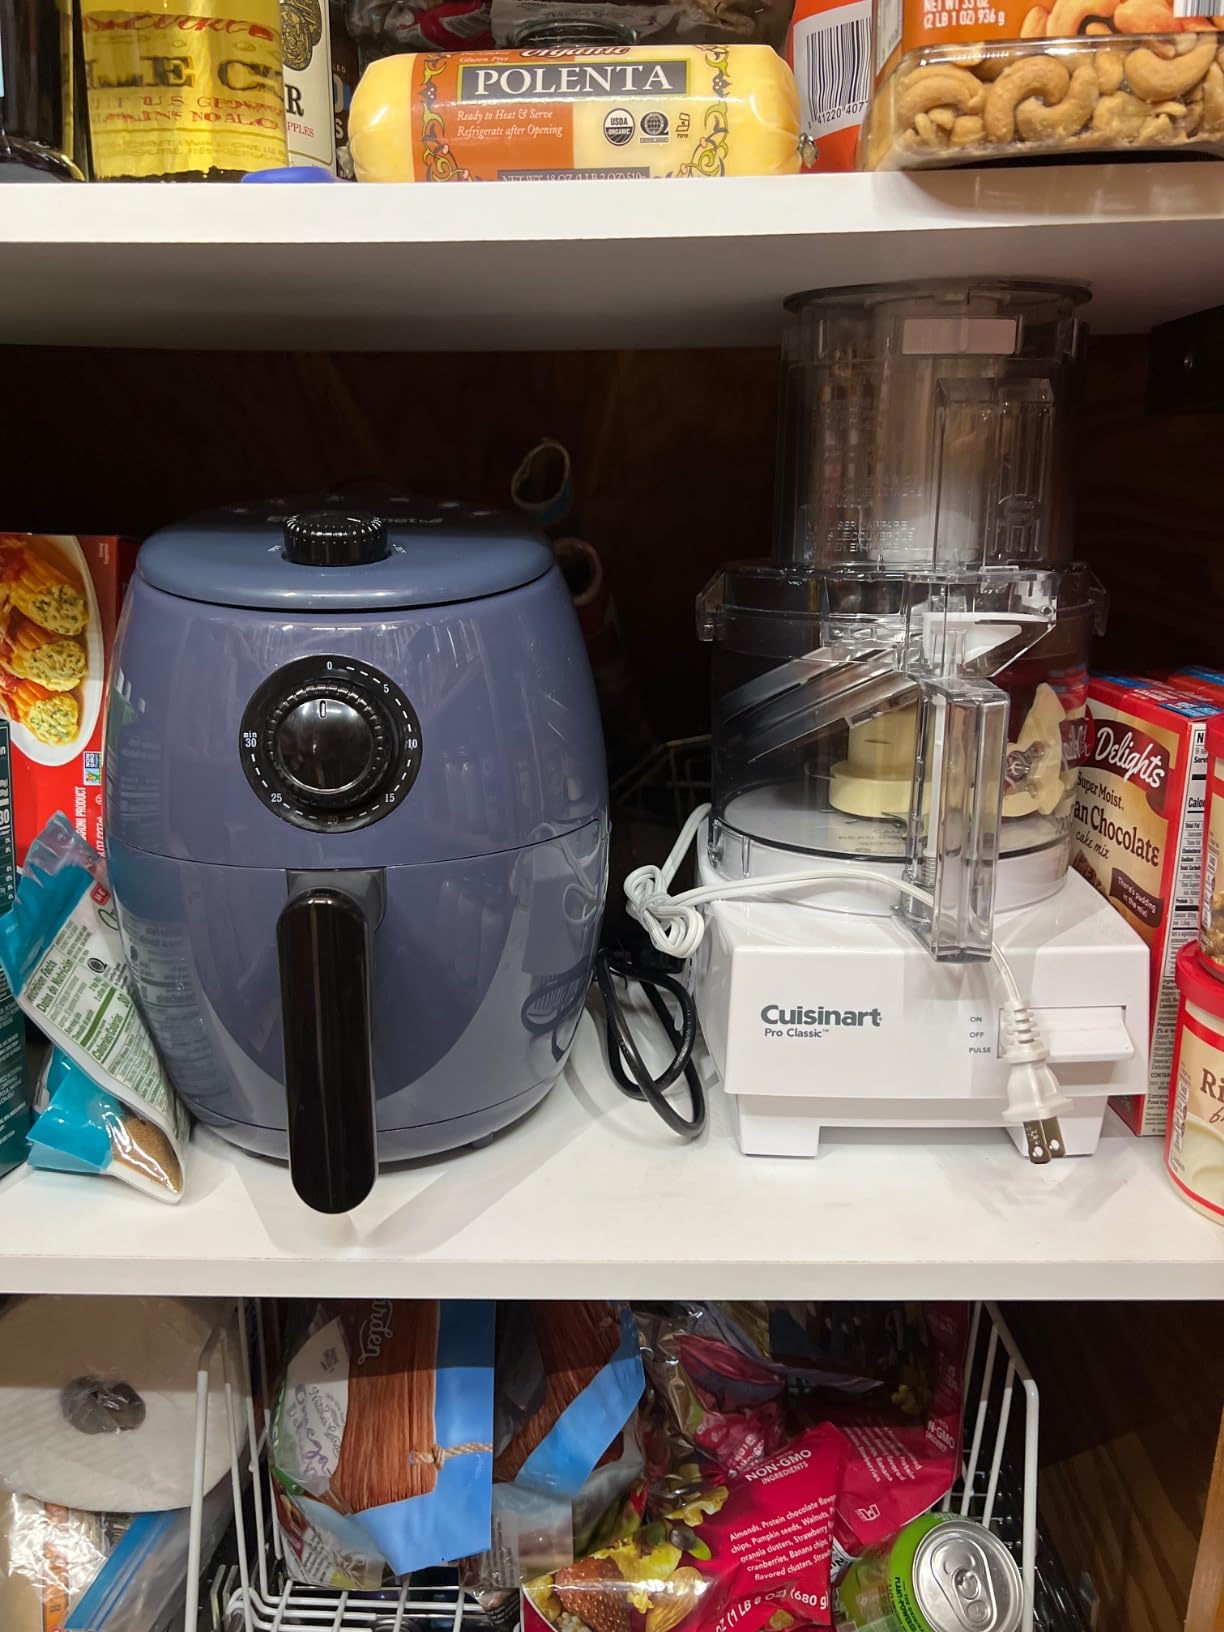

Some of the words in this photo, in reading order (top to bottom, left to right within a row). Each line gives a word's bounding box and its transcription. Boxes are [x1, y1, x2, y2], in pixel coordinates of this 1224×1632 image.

[935, 13, 949, 28] LB
[977, 10, 996, 24] 936
[998, 11, 1006, 26] g
[474, 64, 675, 95] POLENTA
[456, 110, 483, 124] Ready
[485, 111, 494, 120] to
[496, 109, 516, 119] Heat
[517, 109, 528, 119] &
[529, 109, 553, 119] Serve
[610, 117, 629, 126] USDA
[817, 108, 842, 125] 41220
[845, 100, 869, 115] 407
[287, 121, 315, 138] PPLES
[456, 125, 504, 139] Refrigerate
[505, 125, 525, 137] after
[527, 125, 563, 137] Opening
[326, 661, 333, 671] 0
[382, 684, 390, 694] 5
[245, 737, 257, 748] 30
[408, 739, 418, 749] 10
[1095, 727, 1166, 788] Delights
[1077, 771, 1099, 795] Super
[75, 786, 87, 817] PRODUCT
[270, 793, 283, 803] 25
[384, 793, 396, 803] 15
[327, 815, 339, 826] 20
[1076, 831, 1093, 849] cake
[1094, 844, 1110, 859] mix
[1090, 804, 1160, 867] Chocolate
[1128, 897, 1137, 909] the
[1135, 892, 1156, 914] pudding
[760, 1004, 882, 1027] Cuisinart
[764, 1028, 783, 1037] Pro
[968, 1046, 992, 1054] PULSE
[1200, 1067, 1224, 1104] Ri
[744, 1449, 812, 1482] NON-GMO
[761, 1461, 809, 1485] INGREDIENTS
[729, 1524, 763, 1542] Almonds,
[761, 1515, 786, 1529] Protein
[786, 1501, 818, 1520] chocolate
[730, 1542, 752, 1554] chips,
[751, 1530, 780, 1546] Pumpkin
[780, 1523, 802, 1536] seeds,
[801, 1511, 831, 1526] Walnuts,
[766, 1540, 794, 1554] clusters,
[793, 1525, 828, 1544] Strawberry
[746, 1555, 789, 1573] cranberries,
[788, 1544, 813, 1560] Banana
[754, 1568, 786, 1581] flavored
[787, 1559, 814, 1574] clusters,
[789, 1588, 818, 1607] (680
